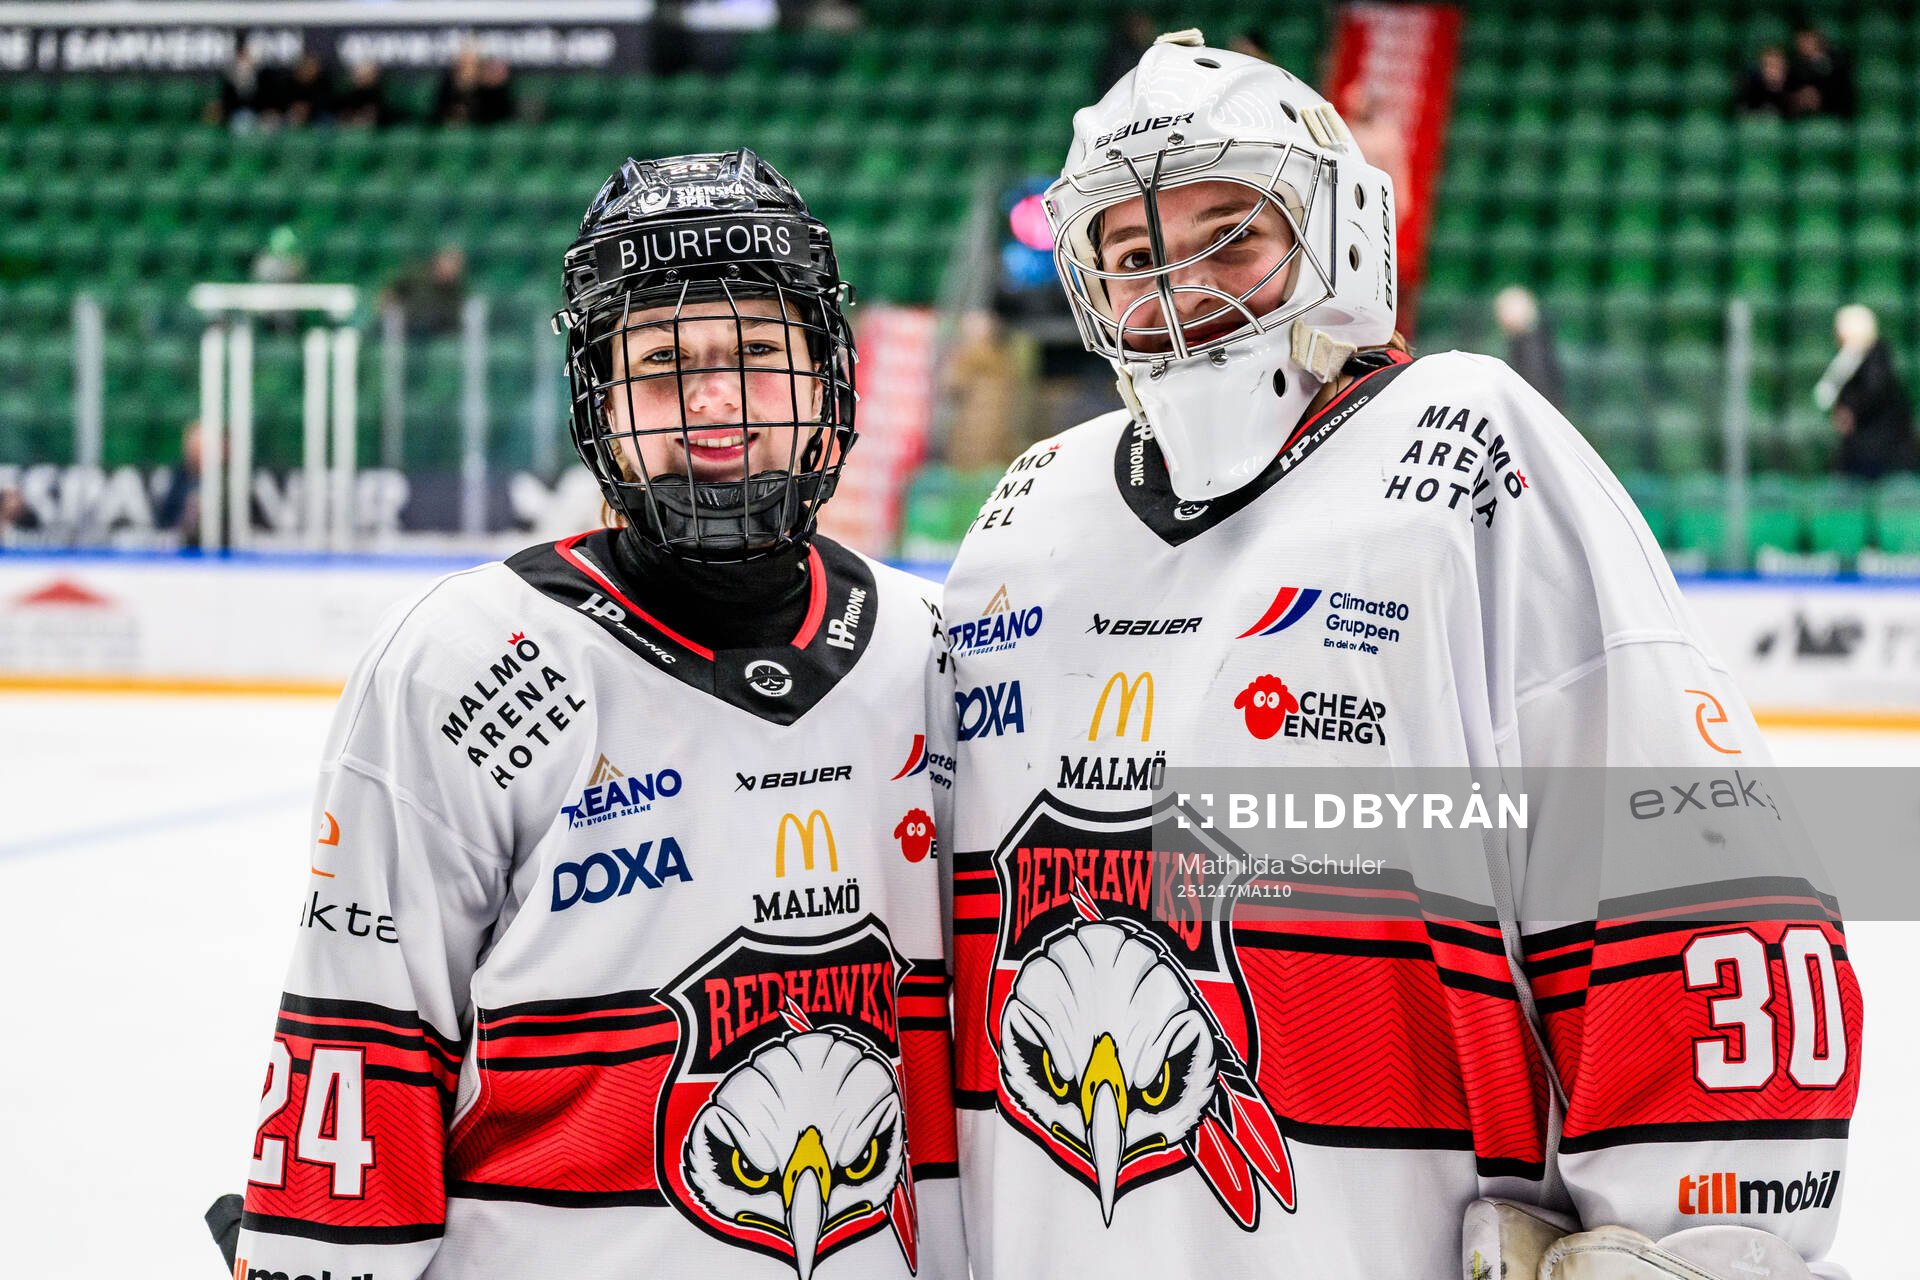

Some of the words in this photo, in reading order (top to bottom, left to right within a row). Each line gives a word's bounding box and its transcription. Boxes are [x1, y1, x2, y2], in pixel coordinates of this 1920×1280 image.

[1094, 111, 1195, 149] BAUER
[619, 224, 792, 270] BJURFORS
[1384, 475, 1474, 512] HOT
[1400, 440, 1498, 528] ARENA
[1109, 616, 1203, 636] BAUER
[1326, 613, 1400, 642] Gruppen
[1329, 592, 1409, 621] Climat80
[948, 606, 1043, 654] TREANO
[1323, 638, 1335, 648] En
[467, 666, 567, 767] ARENA
[1299, 691, 1386, 722] CHEAP
[490, 694, 586, 790] HOTEL
[1284, 714, 1386, 746] ENERGY
[760, 765, 853, 789] BAUER
[1057, 750, 1167, 791] MALMÖ
[573, 818, 583, 829] VI
[587, 812, 617, 826] BYGGER
[621, 804, 652, 817] SKÅNE
[1629, 769, 1782, 821] exak
[550, 837, 693, 912] DOXA
[300, 890, 399, 944] kta
[753, 878, 861, 924] MALMÖ
[1014, 847, 1206, 952] REDHAWKS
[704, 961, 896, 1061] REDHAWKS
[1682, 926, 1850, 1091] 30
[248, 1036, 376, 1201] 24
[1678, 1170, 1841, 1215] tillmobil
